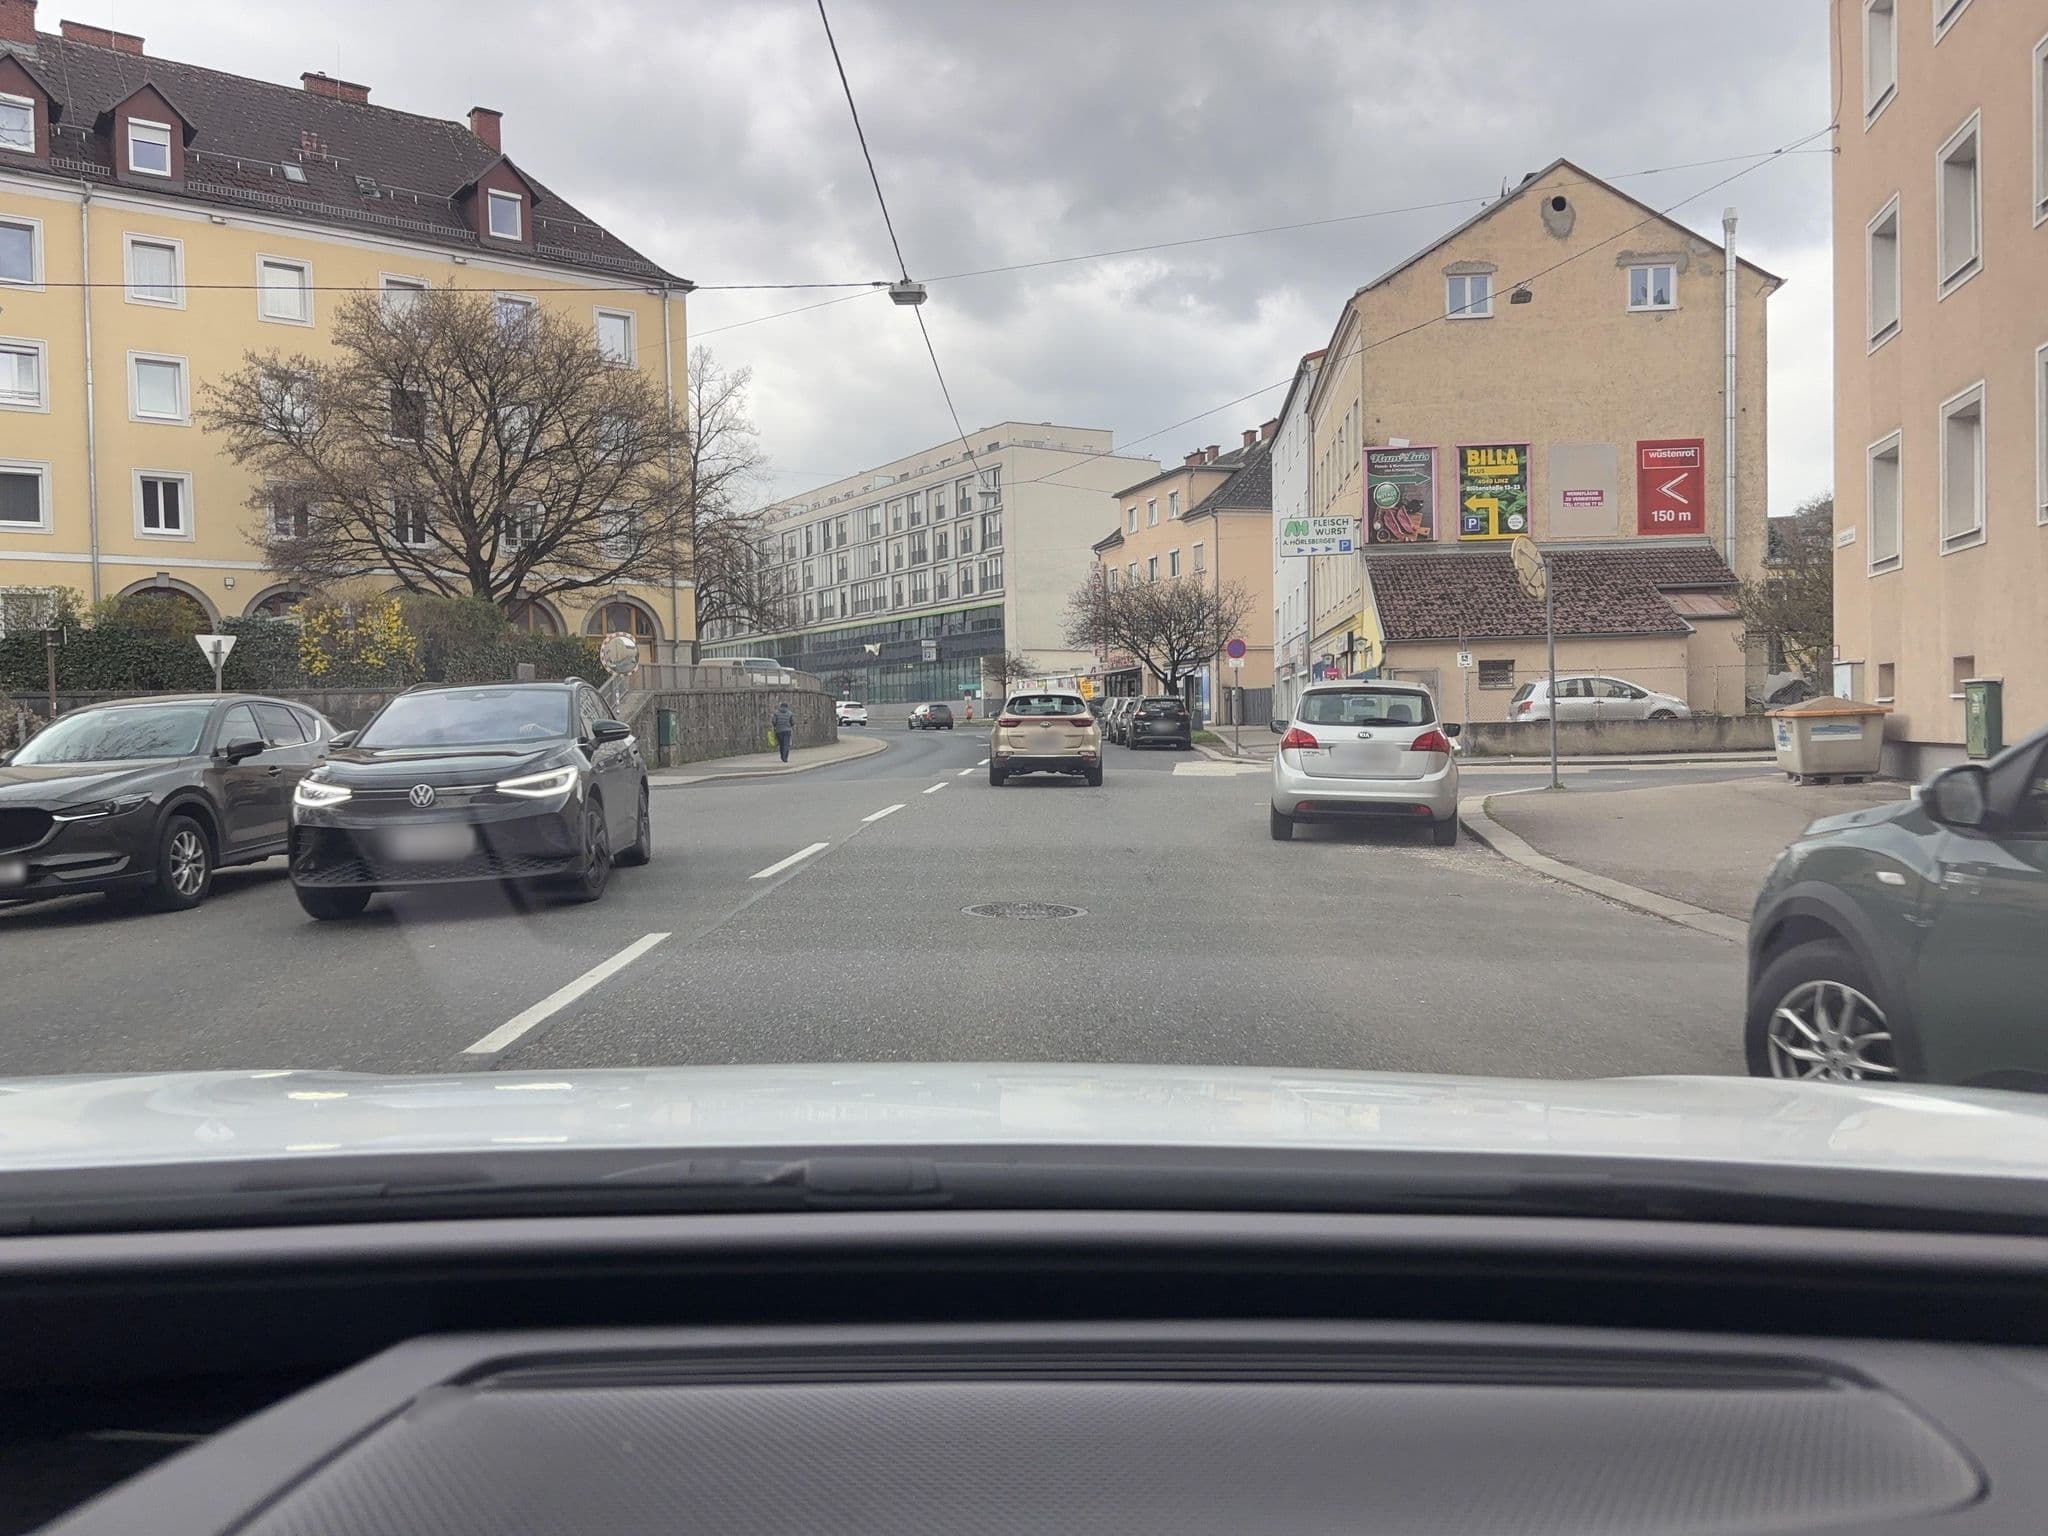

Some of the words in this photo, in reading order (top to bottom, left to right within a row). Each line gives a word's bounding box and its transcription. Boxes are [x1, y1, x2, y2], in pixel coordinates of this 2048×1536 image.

[1466, 448, 1519, 466] BILLA
[1651, 510, 1675, 522] 150
[1679, 512, 1691, 521] m
[1313, 518, 1349, 527] FLEISCH
[1468, 518, 1477, 529] P
[1315, 527, 1348, 536] WURST
[1341, 541, 1350, 551] P
